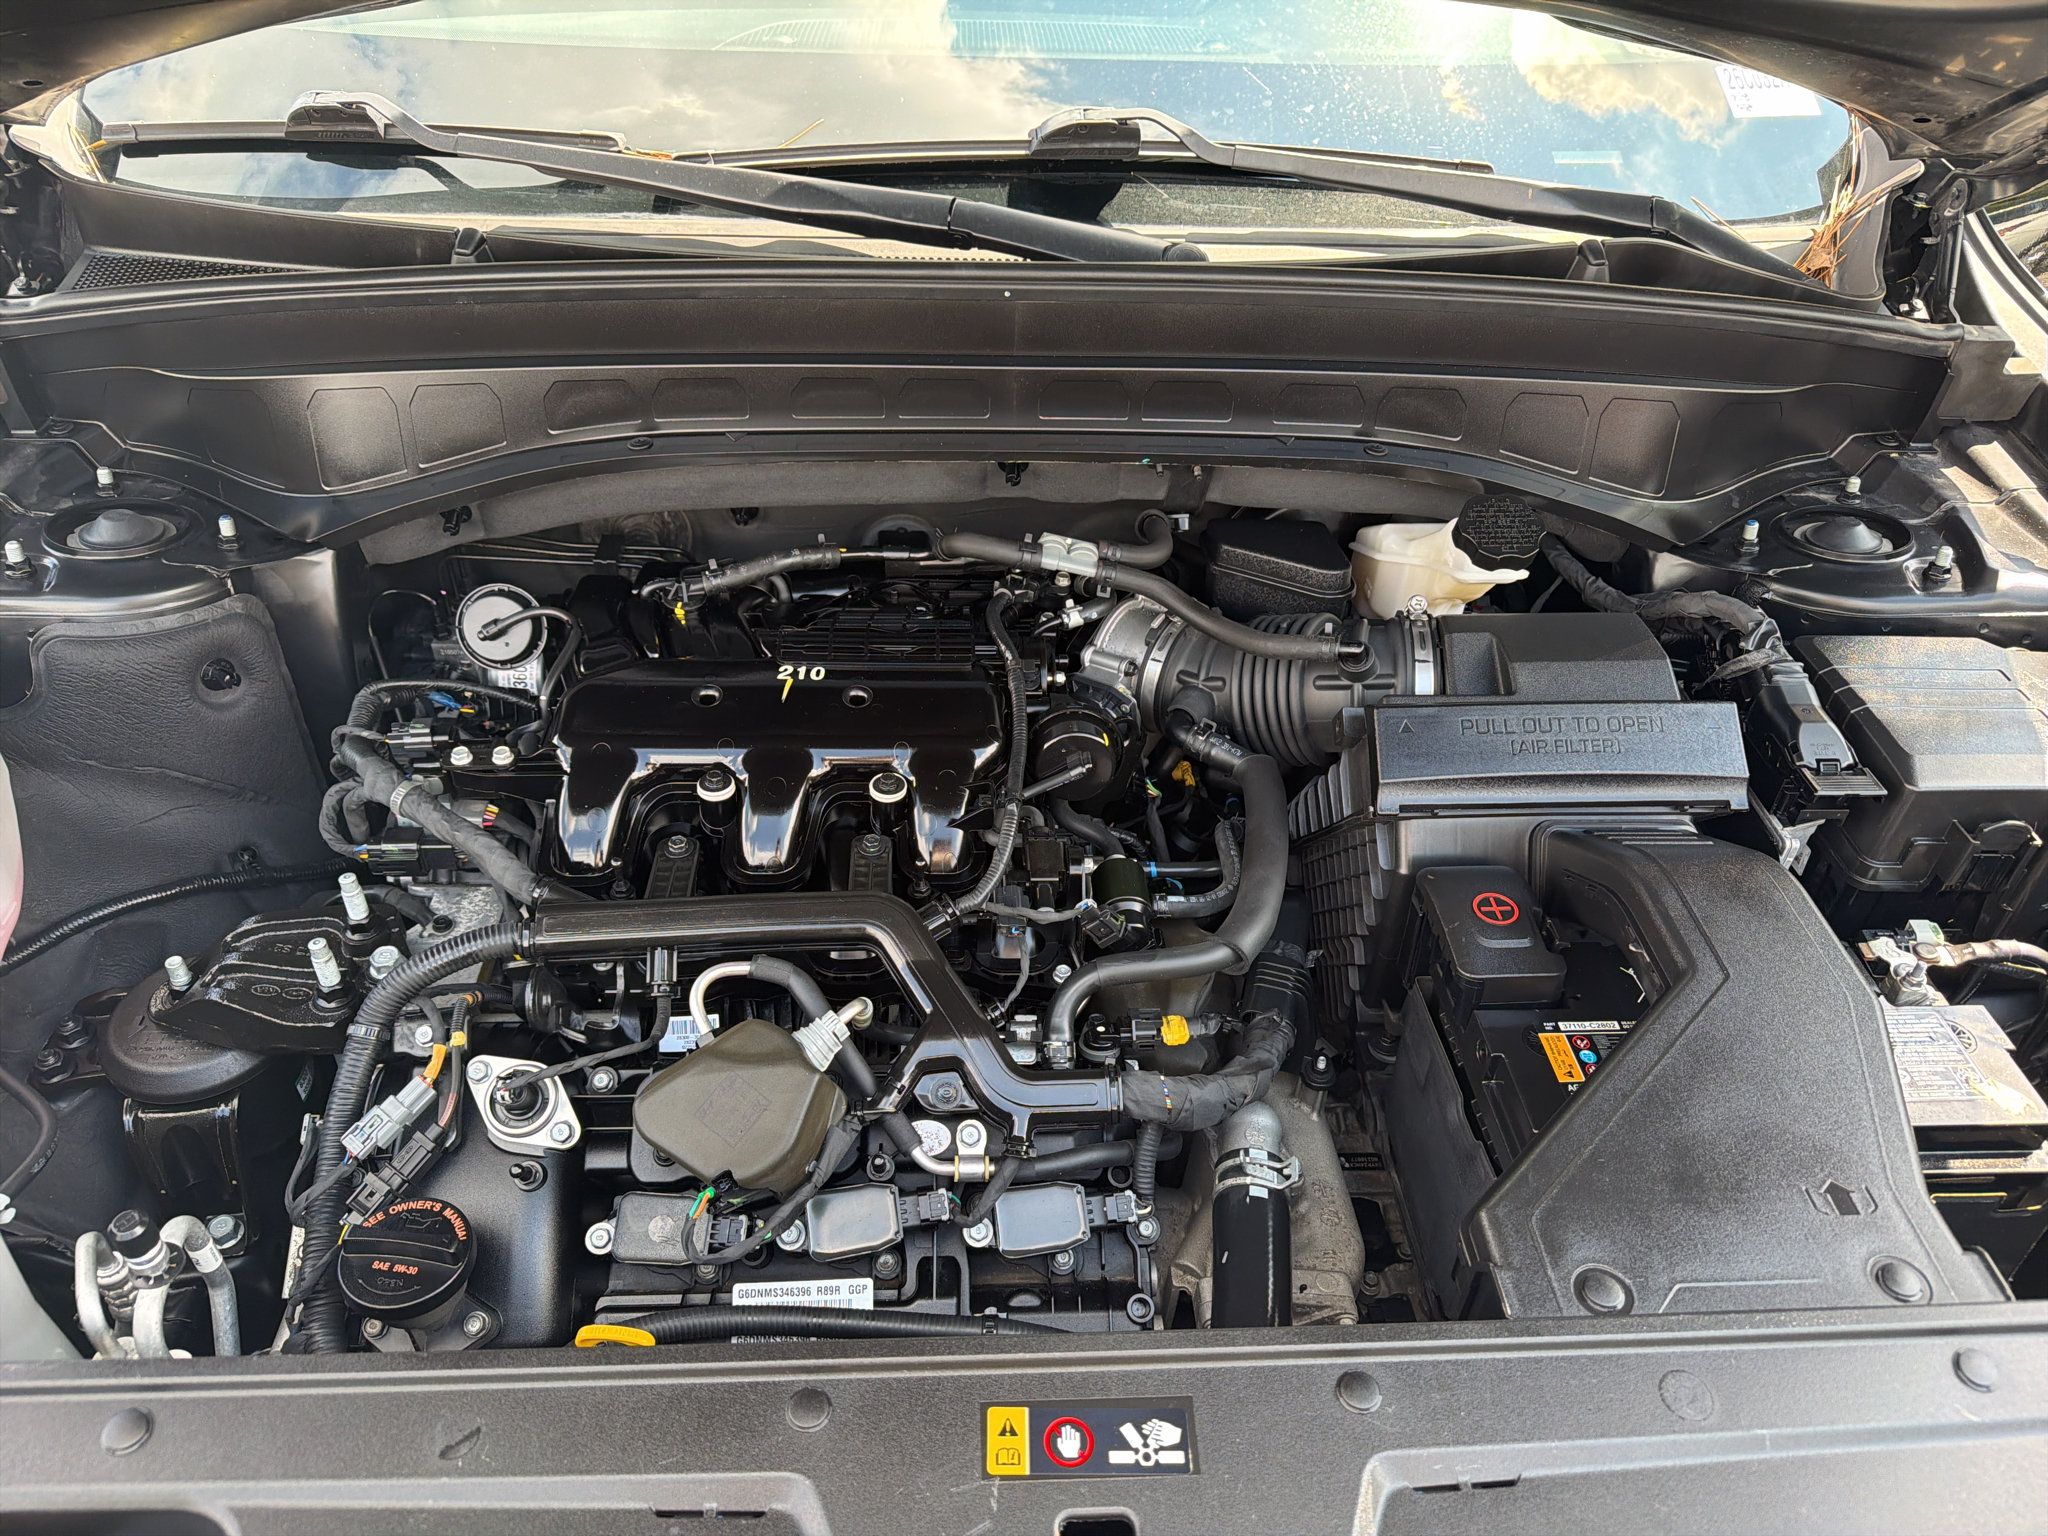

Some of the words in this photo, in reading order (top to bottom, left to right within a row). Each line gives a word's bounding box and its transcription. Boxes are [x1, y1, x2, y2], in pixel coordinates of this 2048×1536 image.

[777, 665, 825, 680] 210
[1459, 717, 1517, 736] PULL
[1522, 716, 1573, 735] OUT
[1576, 716, 1601, 734] TO
[1608, 715, 1665, 733] OPEN
[362, 1211, 386, 1228] SEE
[389, 1200, 442, 1215] OWNER'S
[372, 1260, 391, 1271] SAE
[392, 1263, 419, 1275] 5W-30
[738, 1286, 811, 1299] G6DNMS346396
[816, 1285, 841, 1296] R89R
[848, 1284, 868, 1295] GGP
